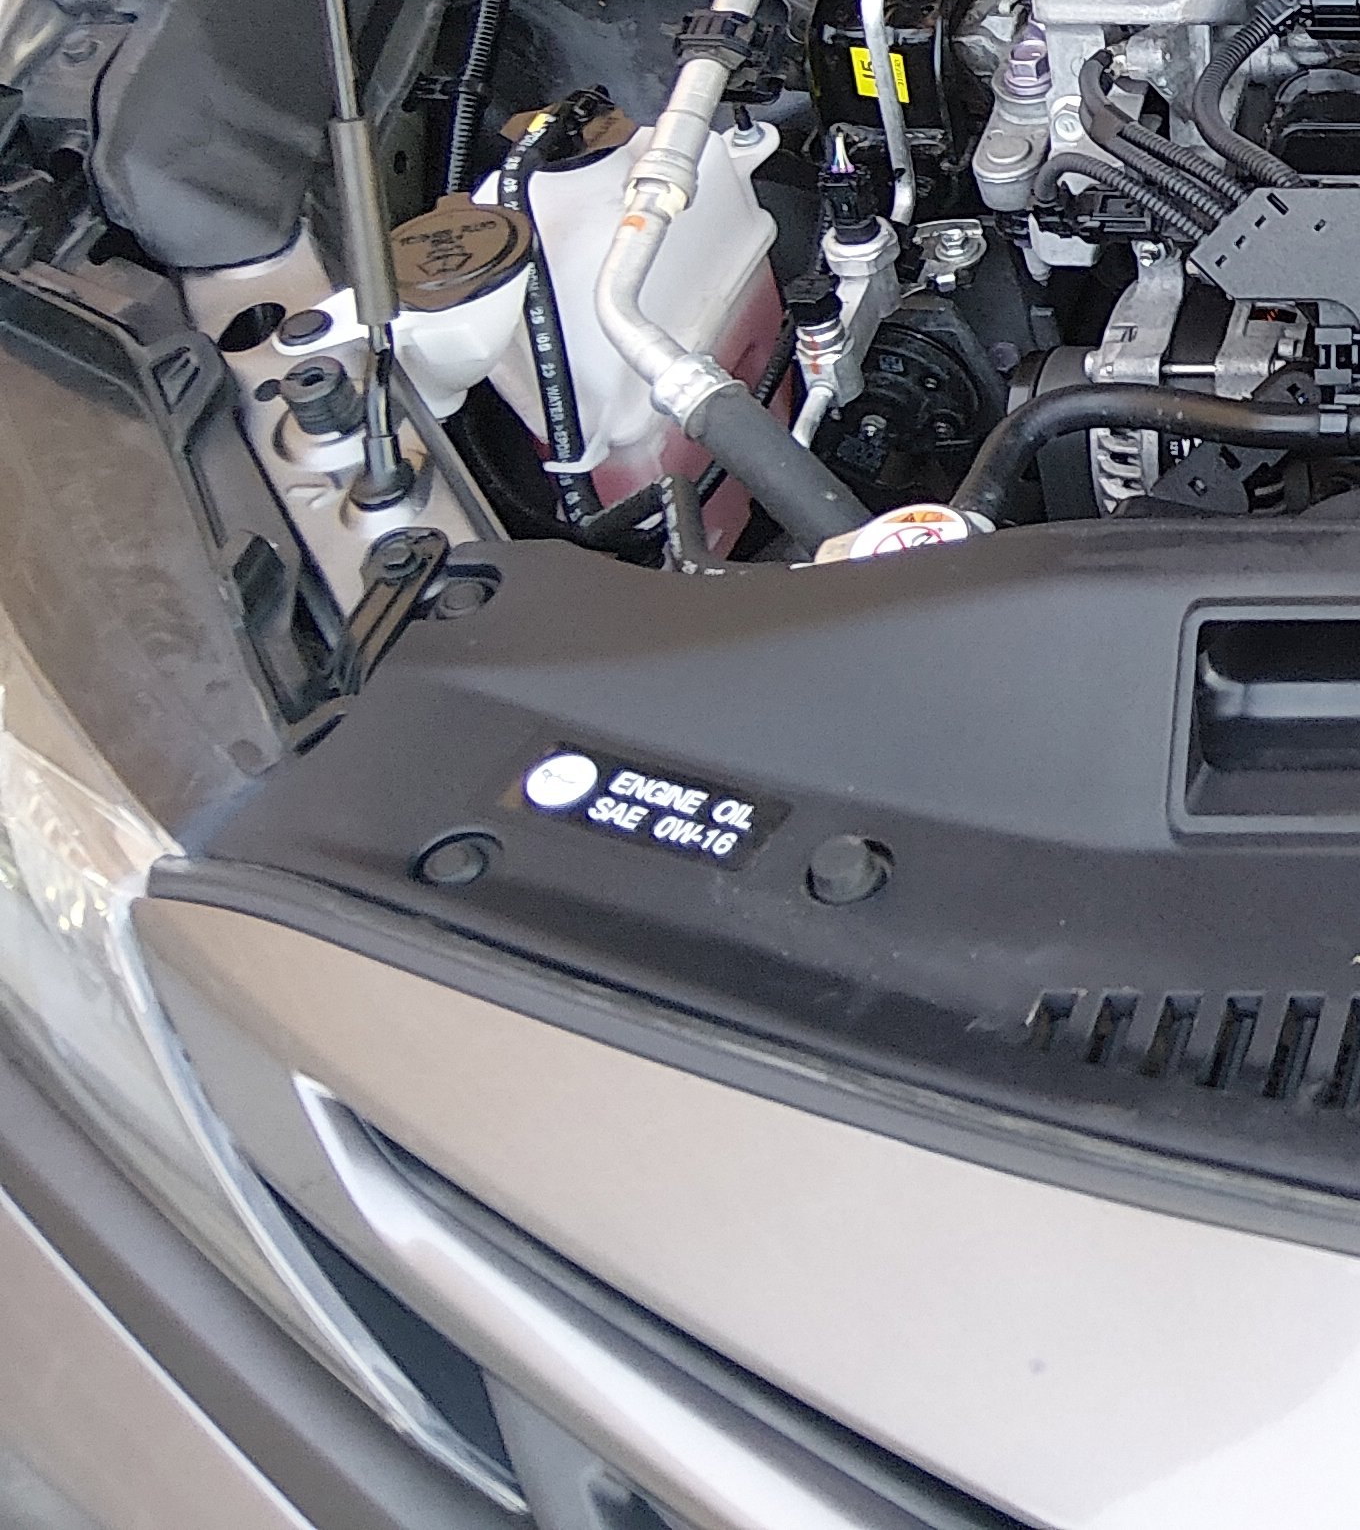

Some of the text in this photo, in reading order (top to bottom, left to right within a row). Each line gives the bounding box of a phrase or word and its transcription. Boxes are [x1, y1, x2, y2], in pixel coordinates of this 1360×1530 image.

[545, 384, 565, 423] WATER
[587, 796, 739, 855] SAE 0W-16
[608, 770, 755, 831] ENGINE OIL
